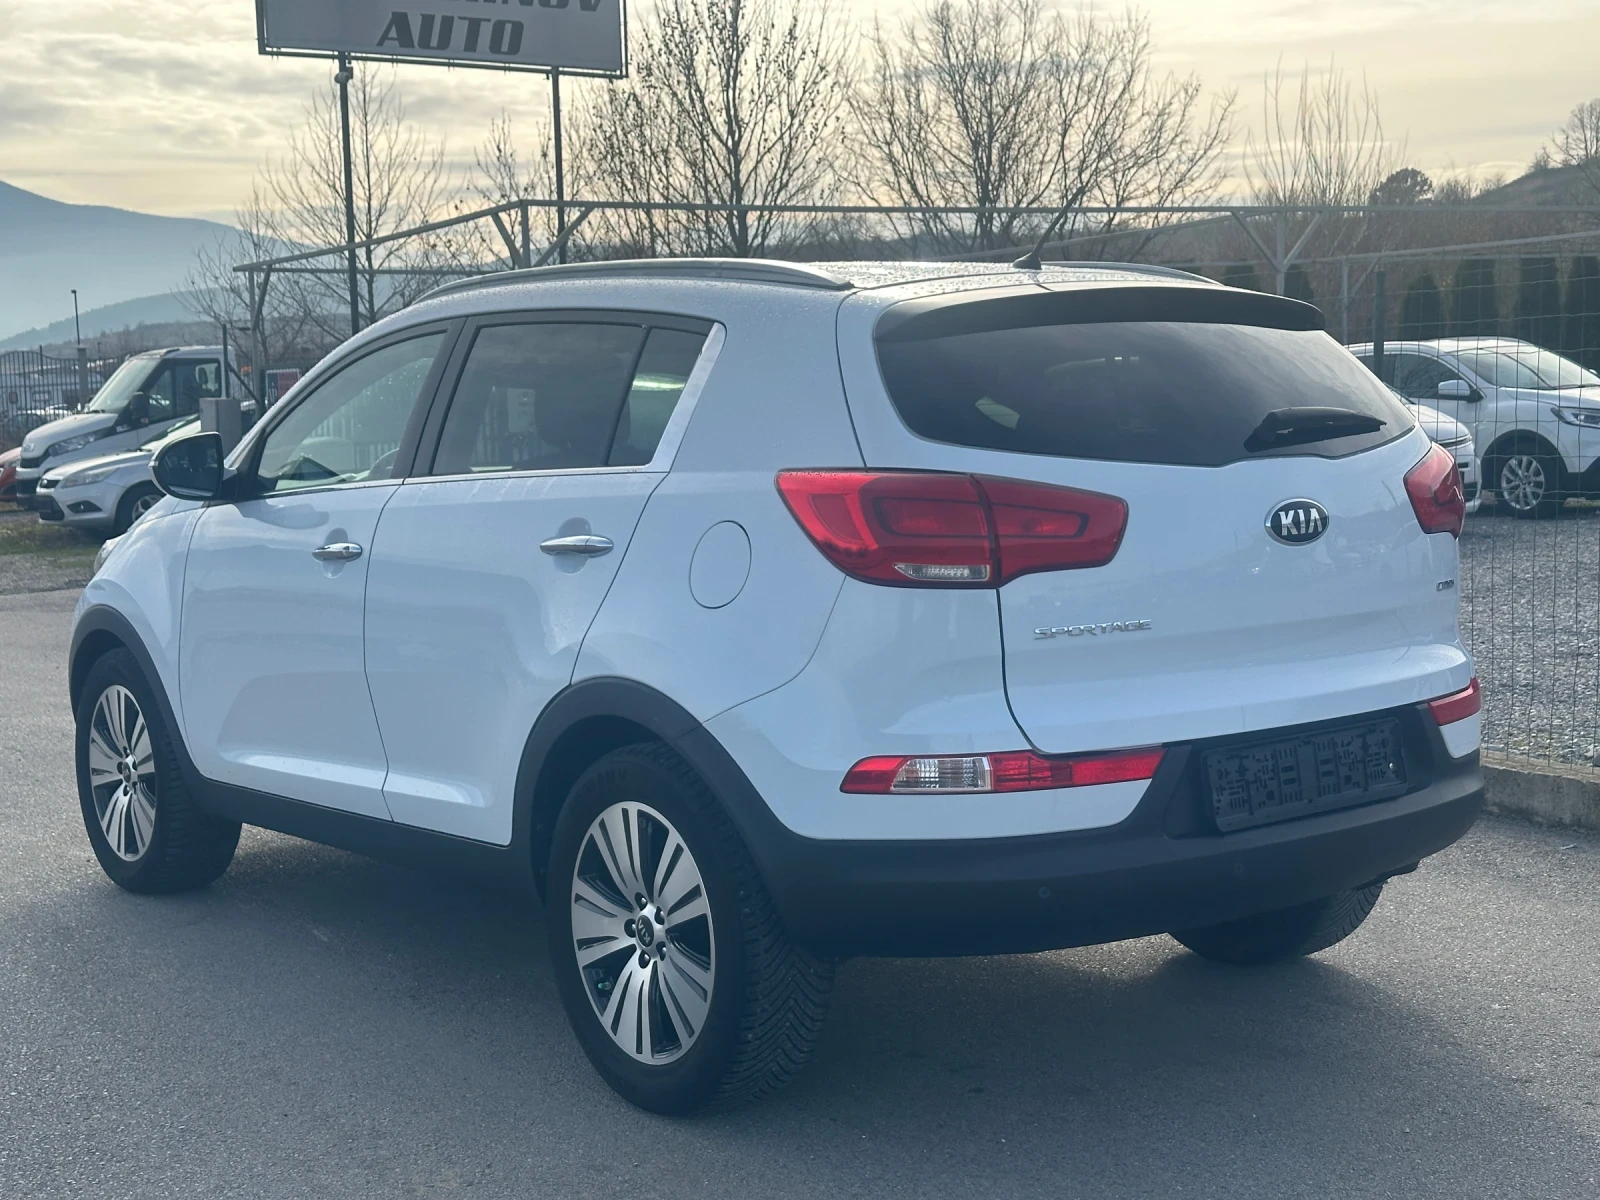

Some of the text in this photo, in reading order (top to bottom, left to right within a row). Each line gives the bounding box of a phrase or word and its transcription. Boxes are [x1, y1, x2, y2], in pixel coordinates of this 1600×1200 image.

[376, 11, 525, 56] AUTO
[1278, 508, 1323, 536] KIA
[1034, 619, 1152, 640] SPORTAGE
